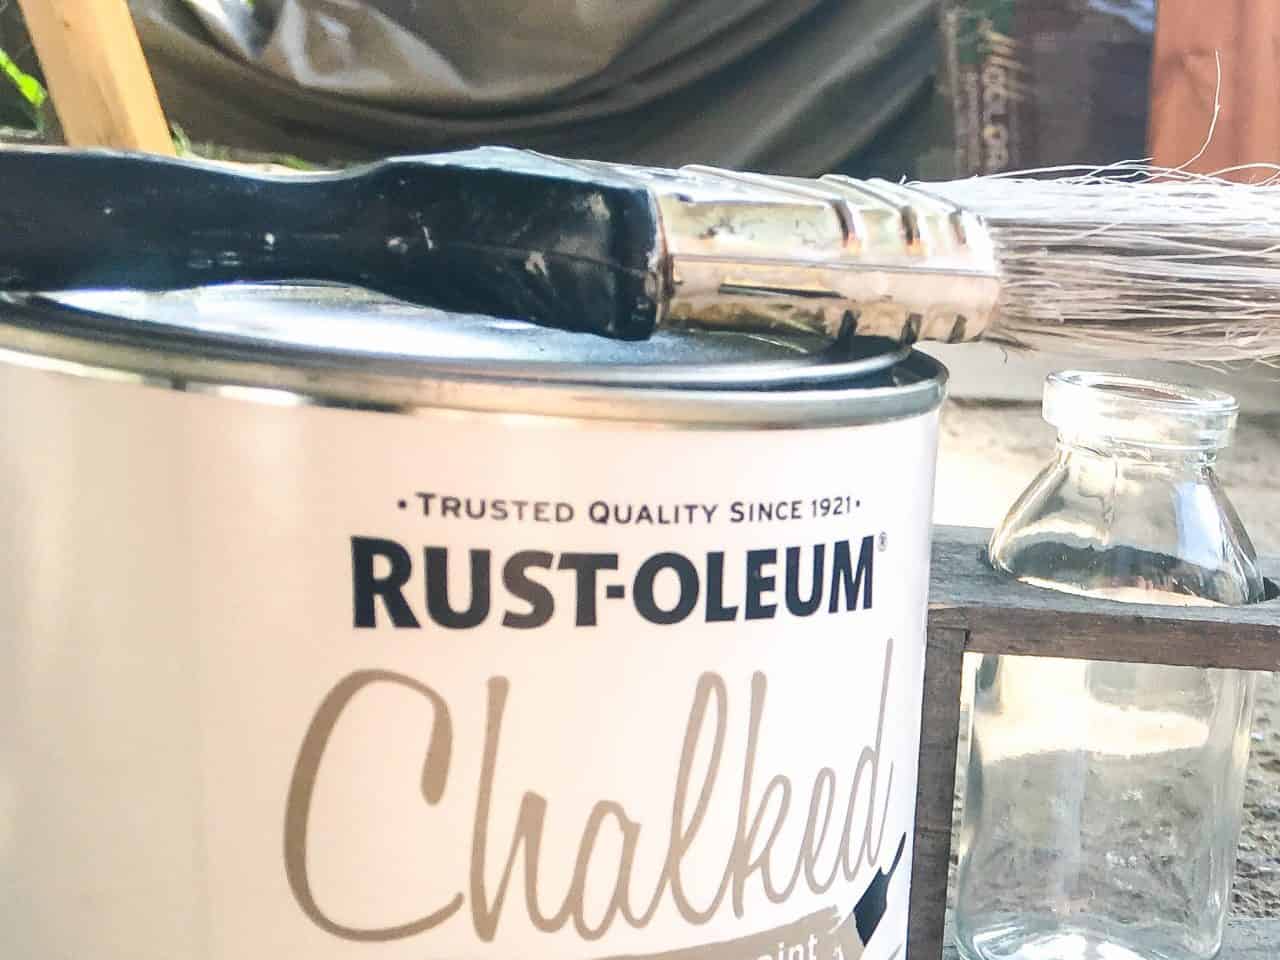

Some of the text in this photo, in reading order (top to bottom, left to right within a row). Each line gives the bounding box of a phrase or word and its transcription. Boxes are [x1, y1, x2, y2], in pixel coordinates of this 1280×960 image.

[588, 501, 719, 526] QUALITY
[729, 501, 804, 523] SINCE
[285, 637, 894, 942] Chalked
